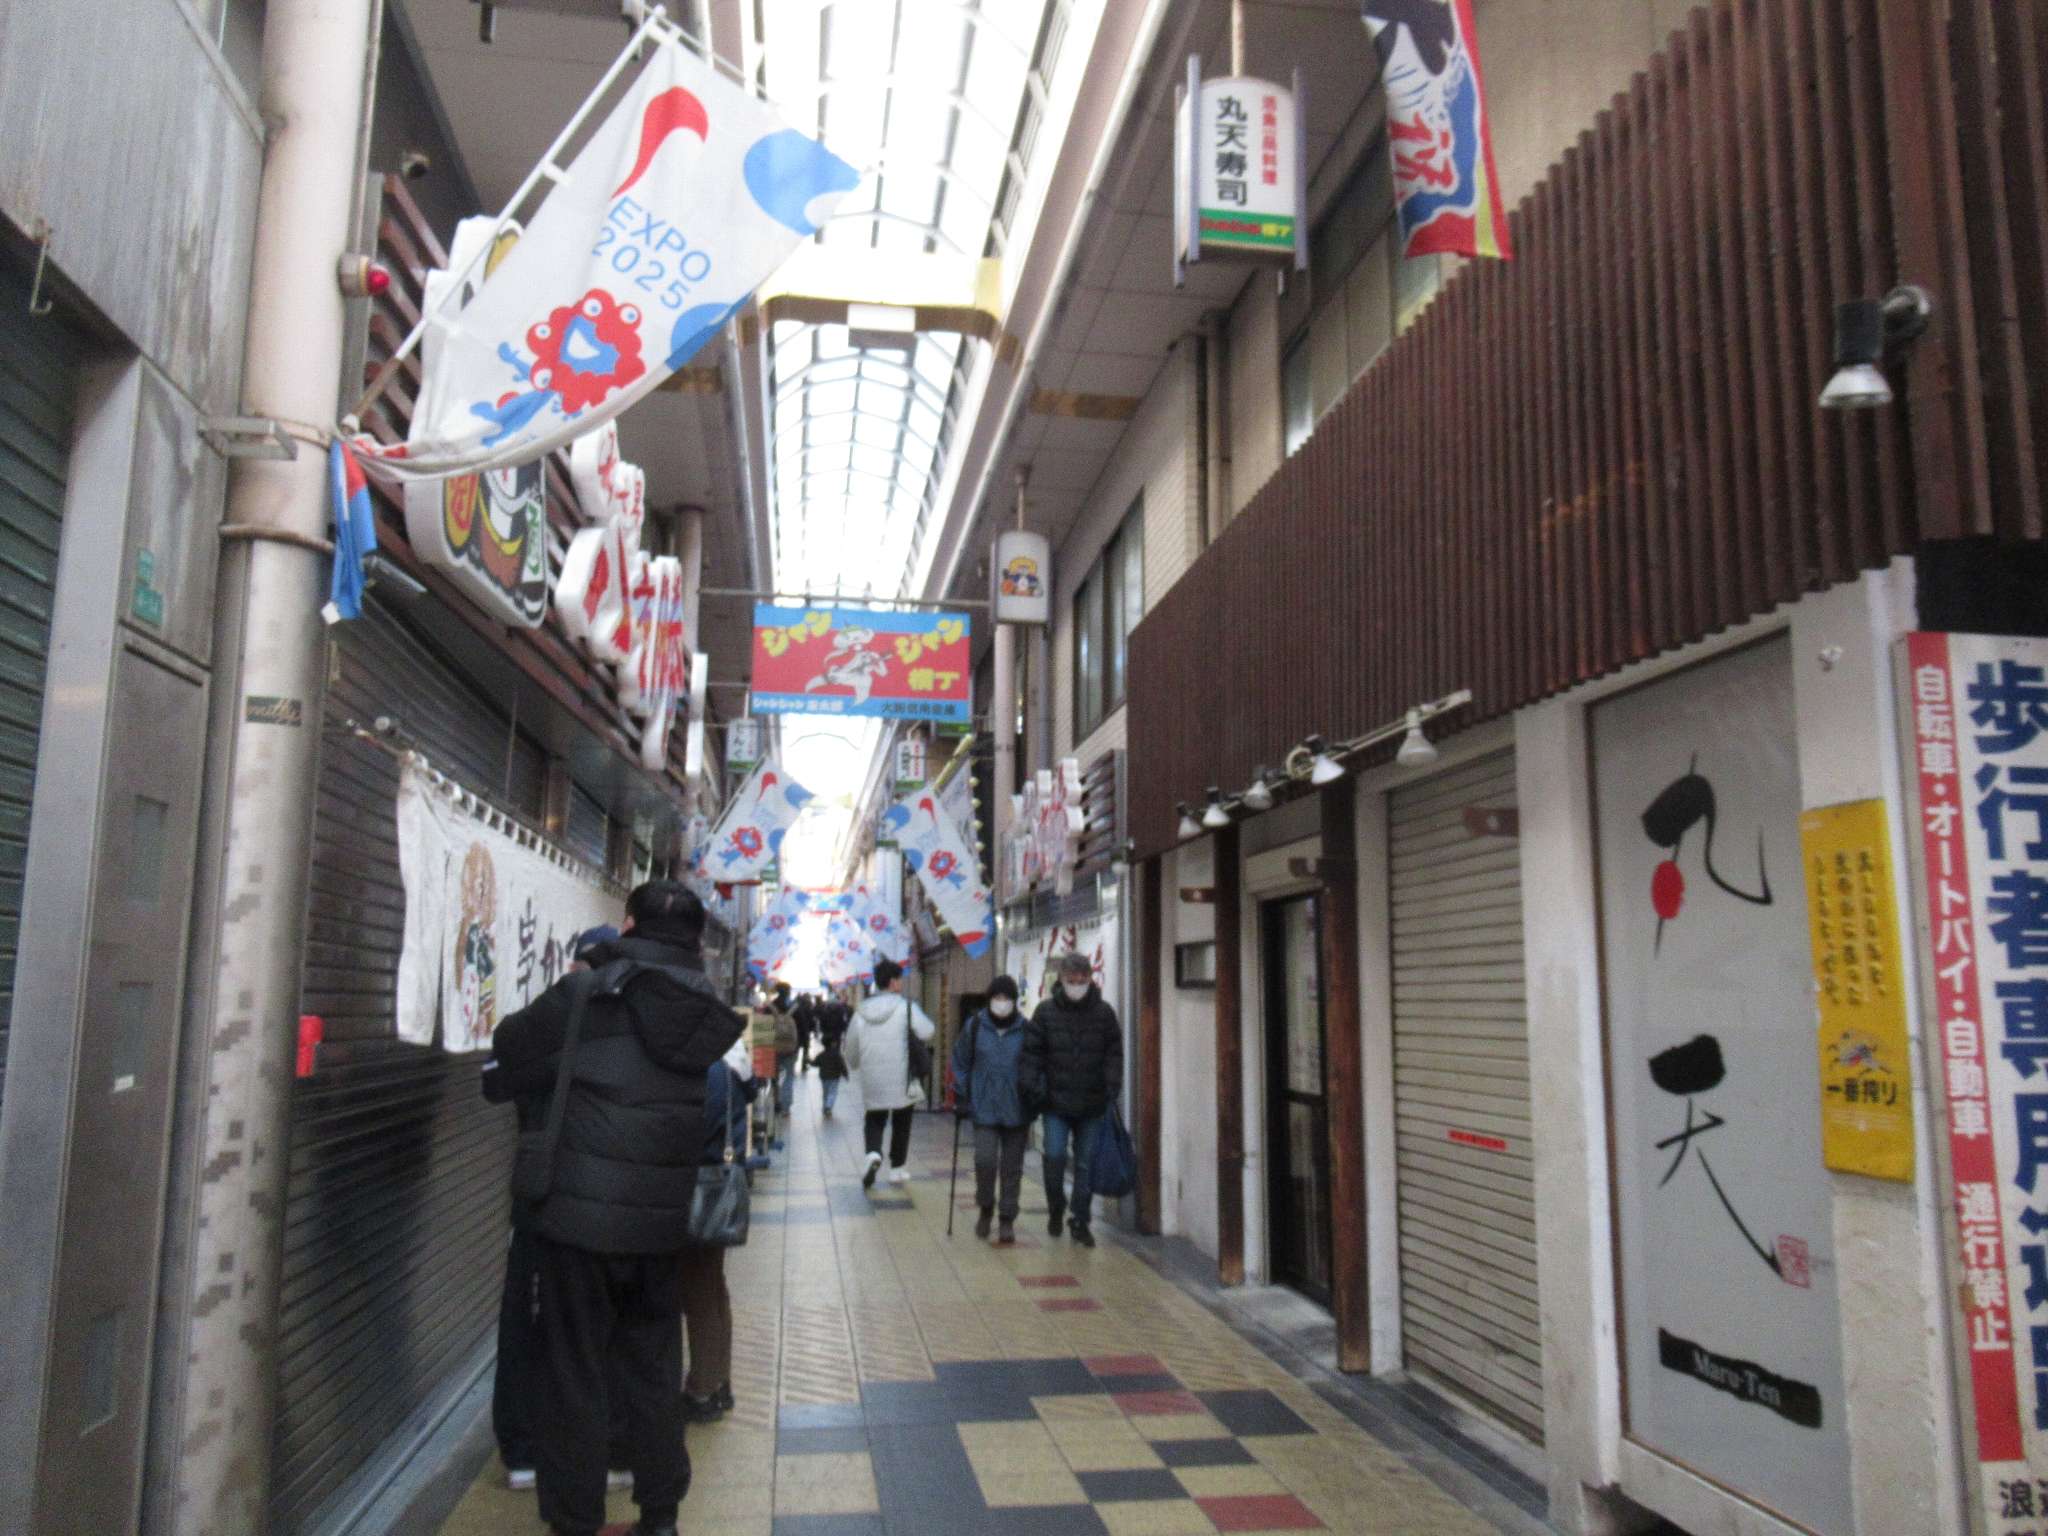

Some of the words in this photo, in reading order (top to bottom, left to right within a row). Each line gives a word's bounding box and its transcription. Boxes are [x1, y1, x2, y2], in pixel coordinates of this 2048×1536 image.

[1215, 95, 1249, 207] 丸天寿司
[591, 227, 690, 311] 2025
[608, 196, 712, 283] EXPO
[1825, 1076, 1899, 1107] 一番搾り
[1967, 659, 2048, 1431] 歩行者専
[1958, 1181, 2010, 1352] 通行禁止
